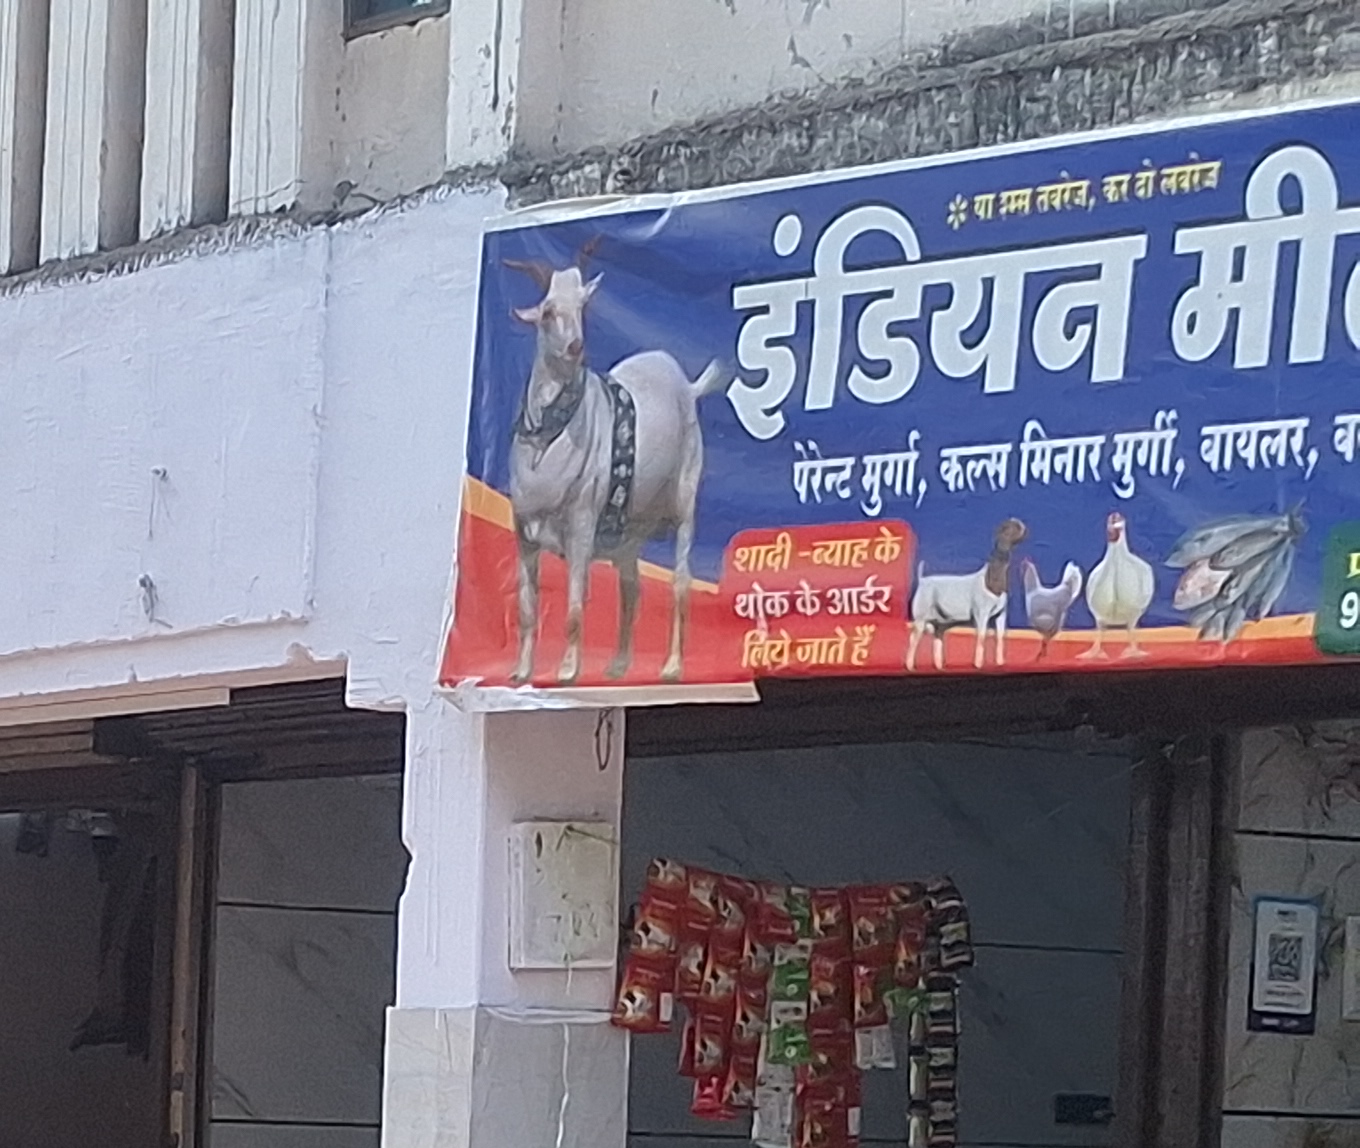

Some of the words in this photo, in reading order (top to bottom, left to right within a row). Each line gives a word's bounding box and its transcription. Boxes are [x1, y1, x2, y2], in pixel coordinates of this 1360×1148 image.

[727, 204, 1149, 441] इंडियन
[1019, 420, 1106, 488] मिनार
[733, 531, 792, 573] शादी
[874, 526, 903, 564] के
[734, 581, 791, 620] थोक
[794, 578, 823, 616] के
[826, 574, 893, 615] आर्डर
[795, 625, 848, 666] जाते
